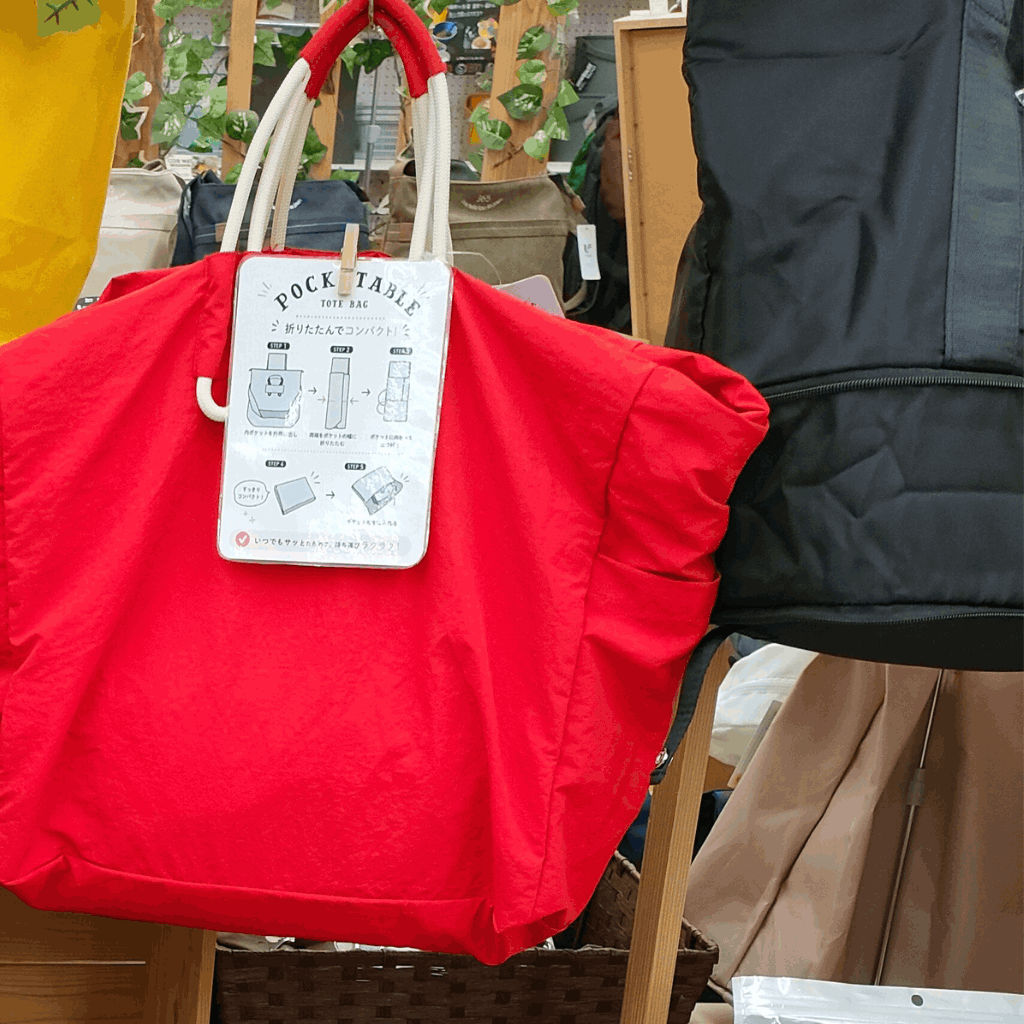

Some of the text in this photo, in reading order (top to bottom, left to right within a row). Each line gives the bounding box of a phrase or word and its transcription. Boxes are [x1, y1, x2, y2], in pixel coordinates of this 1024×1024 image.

[274, 271, 421, 317] POCKTABLE
[320, 299, 369, 309] TOTE BAG
